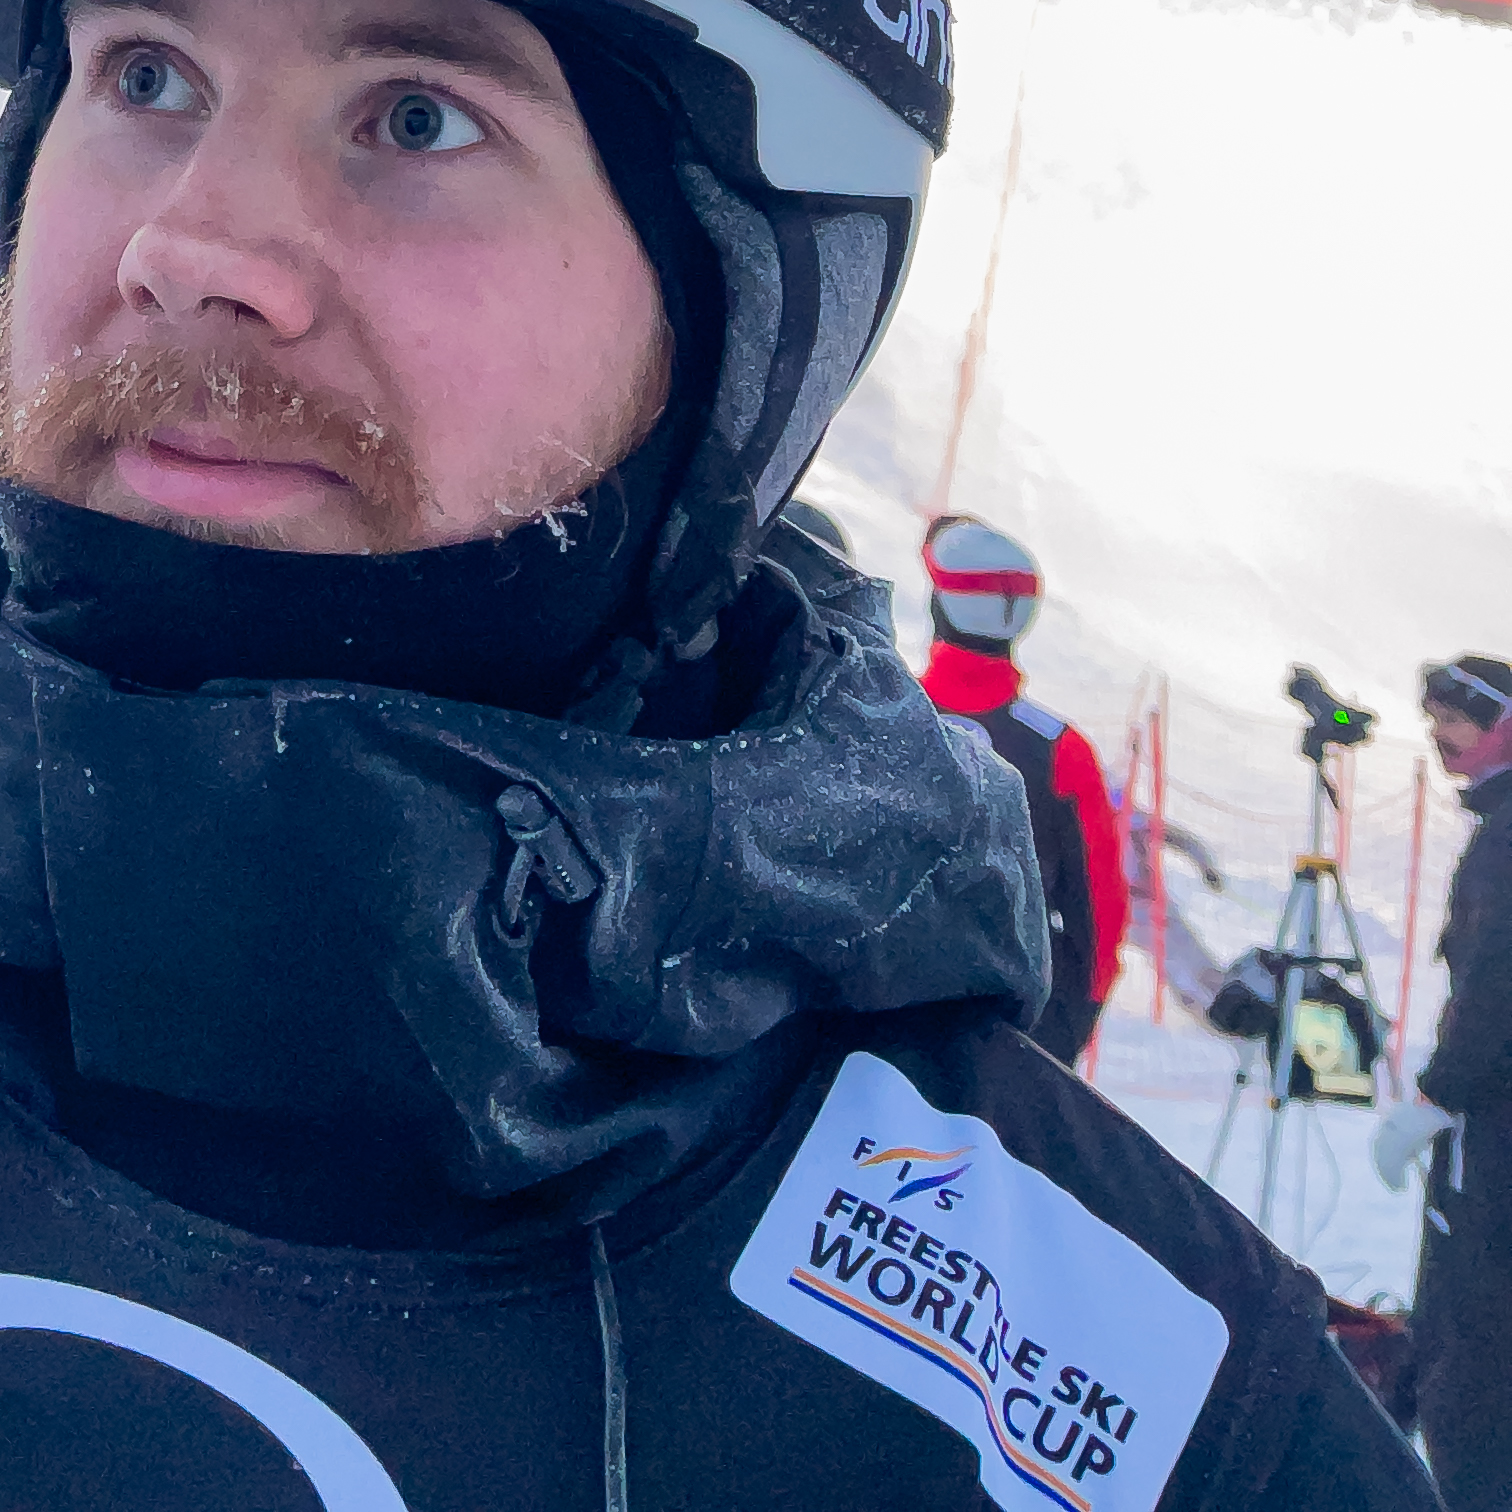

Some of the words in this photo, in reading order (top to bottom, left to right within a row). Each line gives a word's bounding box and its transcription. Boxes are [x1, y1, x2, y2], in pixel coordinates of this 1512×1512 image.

[853, 1136, 964, 1211] FIS
[809, 1221, 999, 1385] WORLD
[1003, 1386, 1117, 1482] CUP
[823, 1187, 1048, 1383] FREESTLE
[1051, 1365, 1138, 1443] SKI
